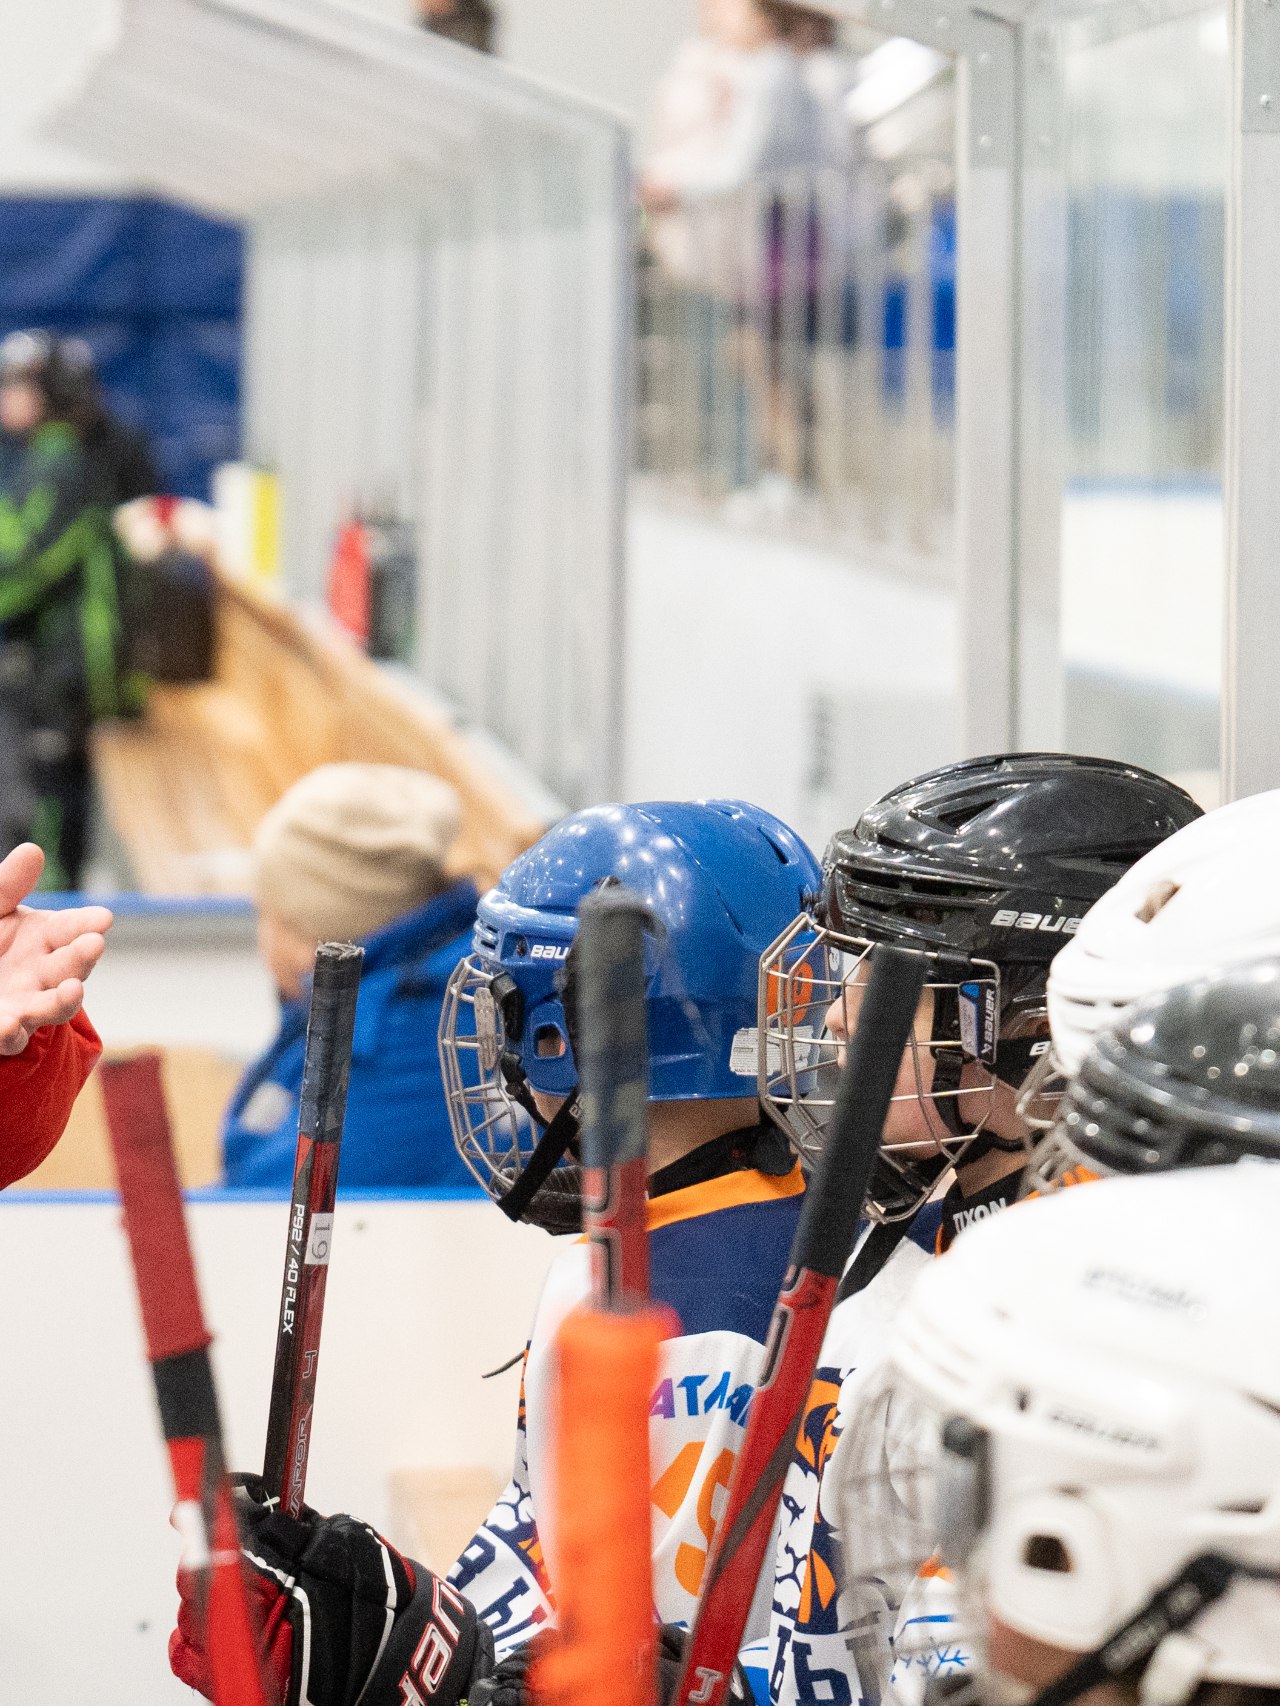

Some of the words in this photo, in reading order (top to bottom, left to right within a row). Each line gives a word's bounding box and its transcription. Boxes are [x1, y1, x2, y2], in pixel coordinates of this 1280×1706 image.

[990, 909, 1082, 935] BAUE
[530, 944, 569, 960] BAU
[291, 1203, 305, 1242] P92
[287, 1258, 299, 1283] 40
[282, 1286, 297, 1335] FLEX
[648, 1371, 754, 1428] АТЛА
